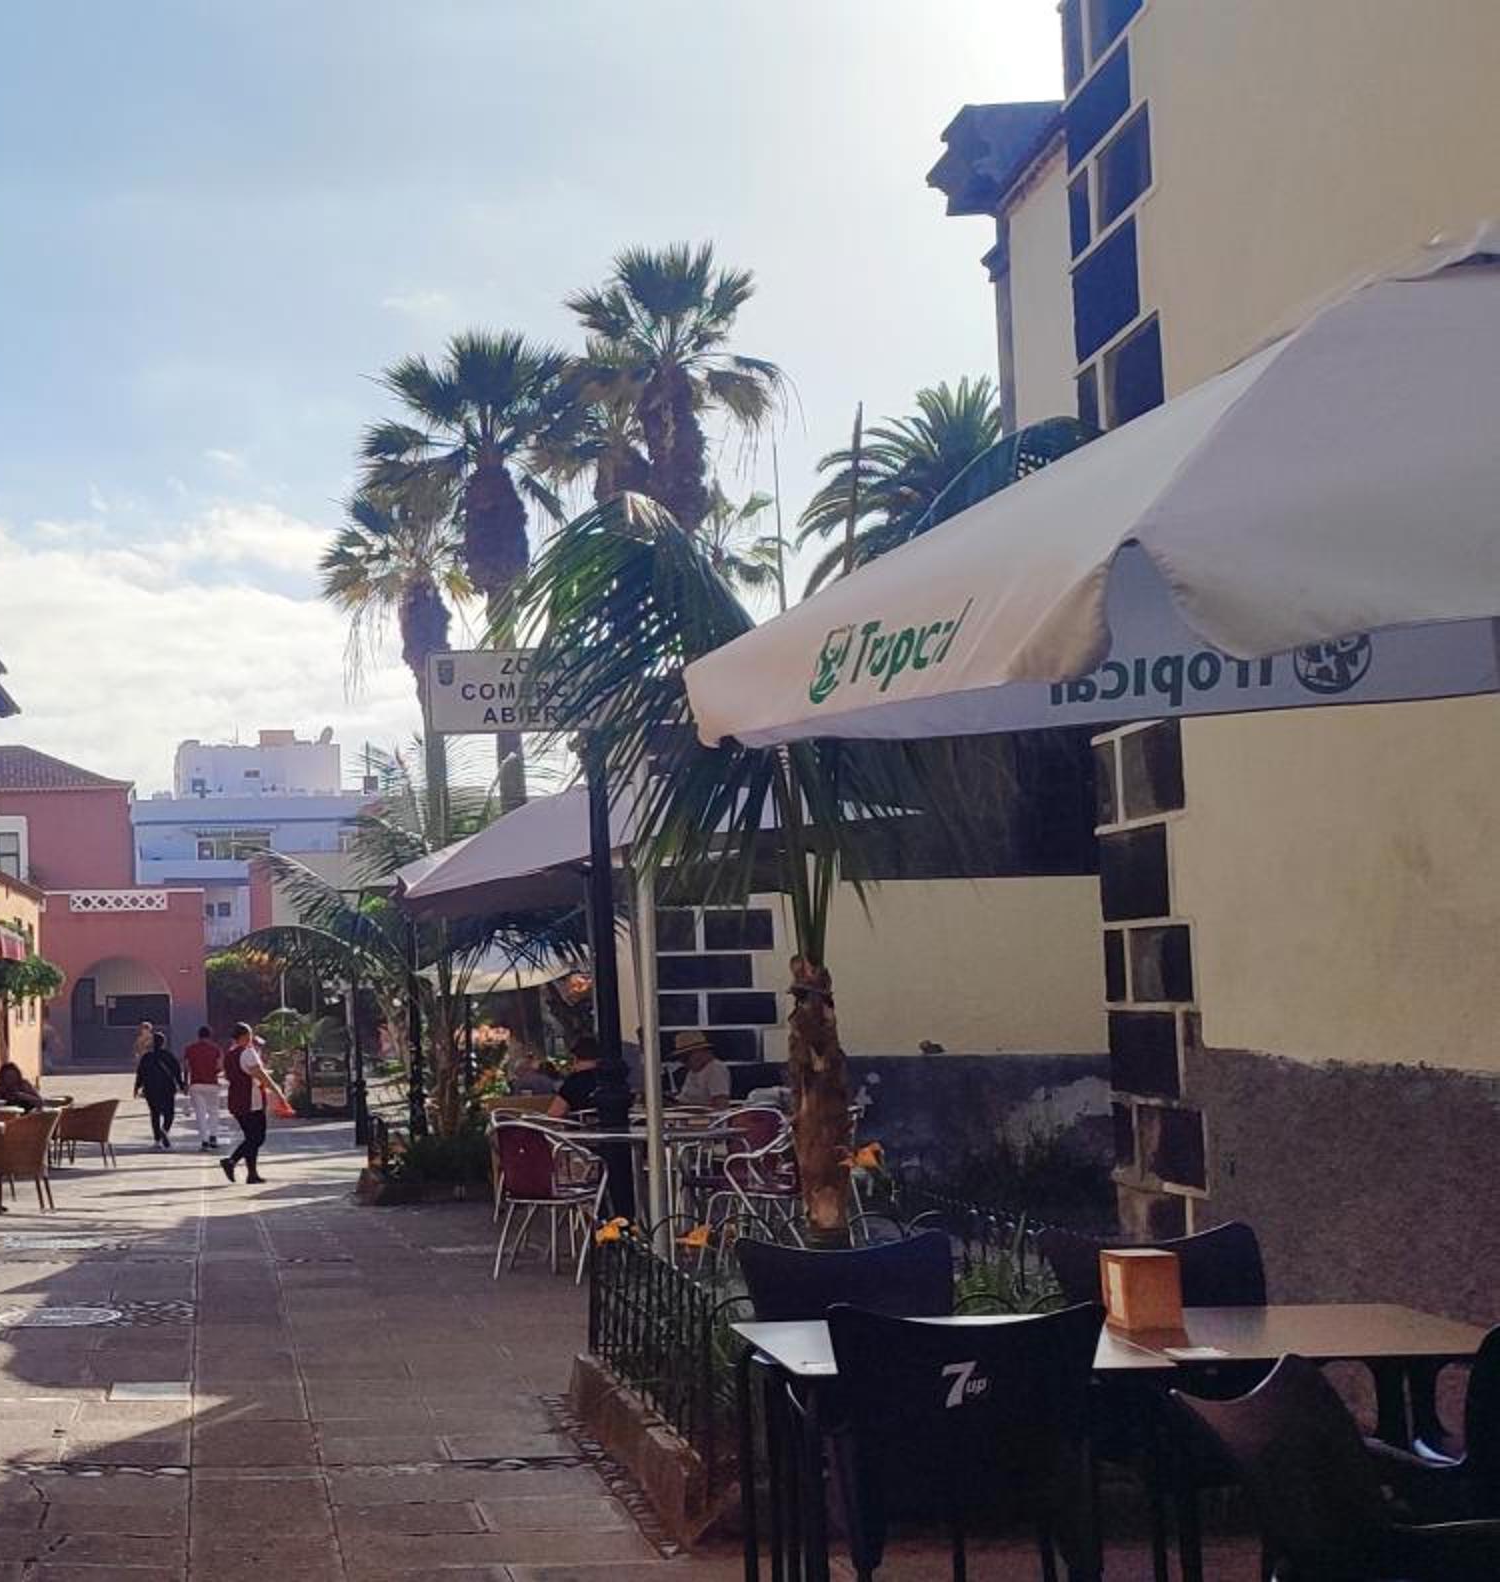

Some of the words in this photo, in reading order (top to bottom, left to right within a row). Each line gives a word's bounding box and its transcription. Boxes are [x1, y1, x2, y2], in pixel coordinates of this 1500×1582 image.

[851, 597, 974, 693] Tropcl
[483, 705, 592, 725] ABIER
[941, 1360, 988, 1409] 7up
